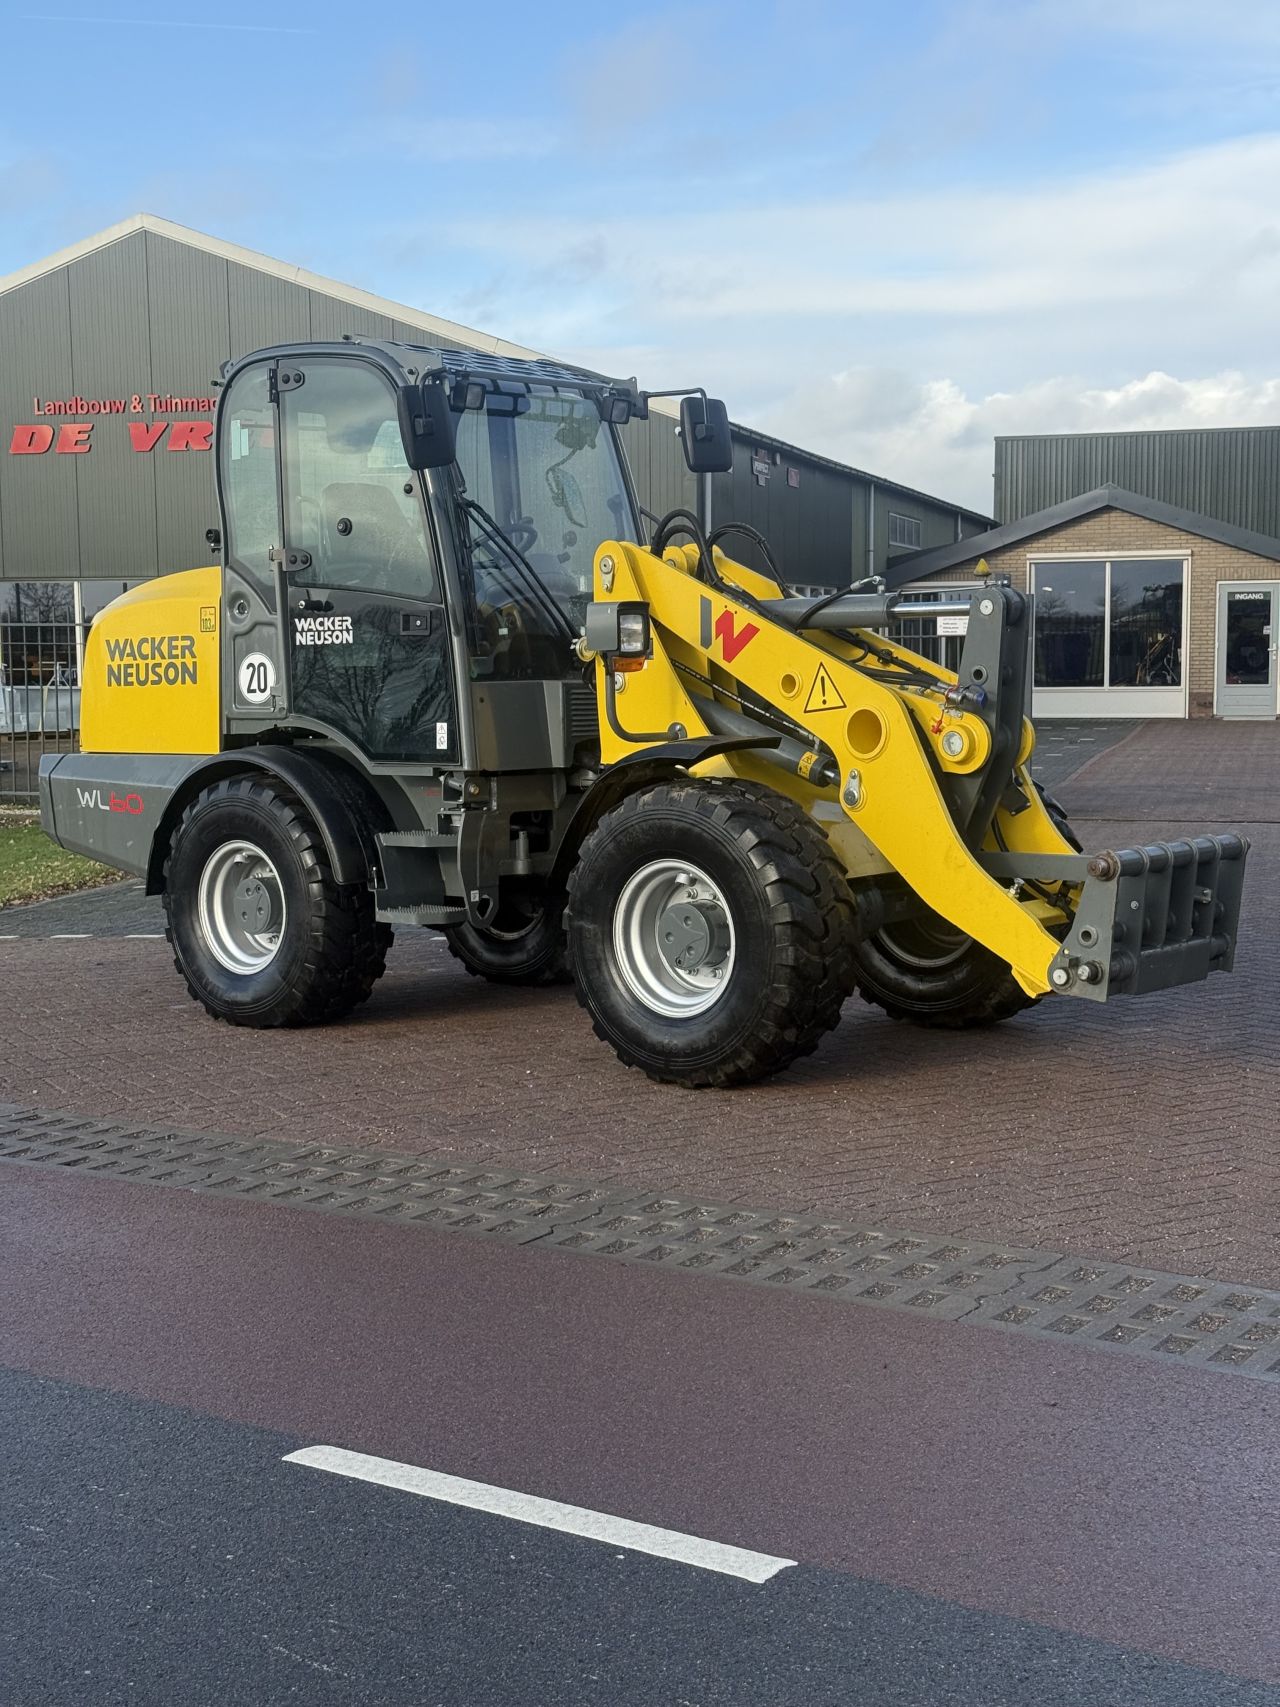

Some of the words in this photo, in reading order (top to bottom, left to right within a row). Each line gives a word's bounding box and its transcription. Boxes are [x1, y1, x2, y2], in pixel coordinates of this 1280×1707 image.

[34, 397, 126, 415] Landbouw
[130, 395, 144, 413] &
[9, 424, 94, 454] DE
[294, 616, 353, 632] WACKER
[105, 635, 198, 662] WACKER
[295, 630, 354, 646] NEUSON
[107, 661, 198, 687] NEUSON
[246, 662, 268, 694] 20
[76, 787, 145, 815] WL60
